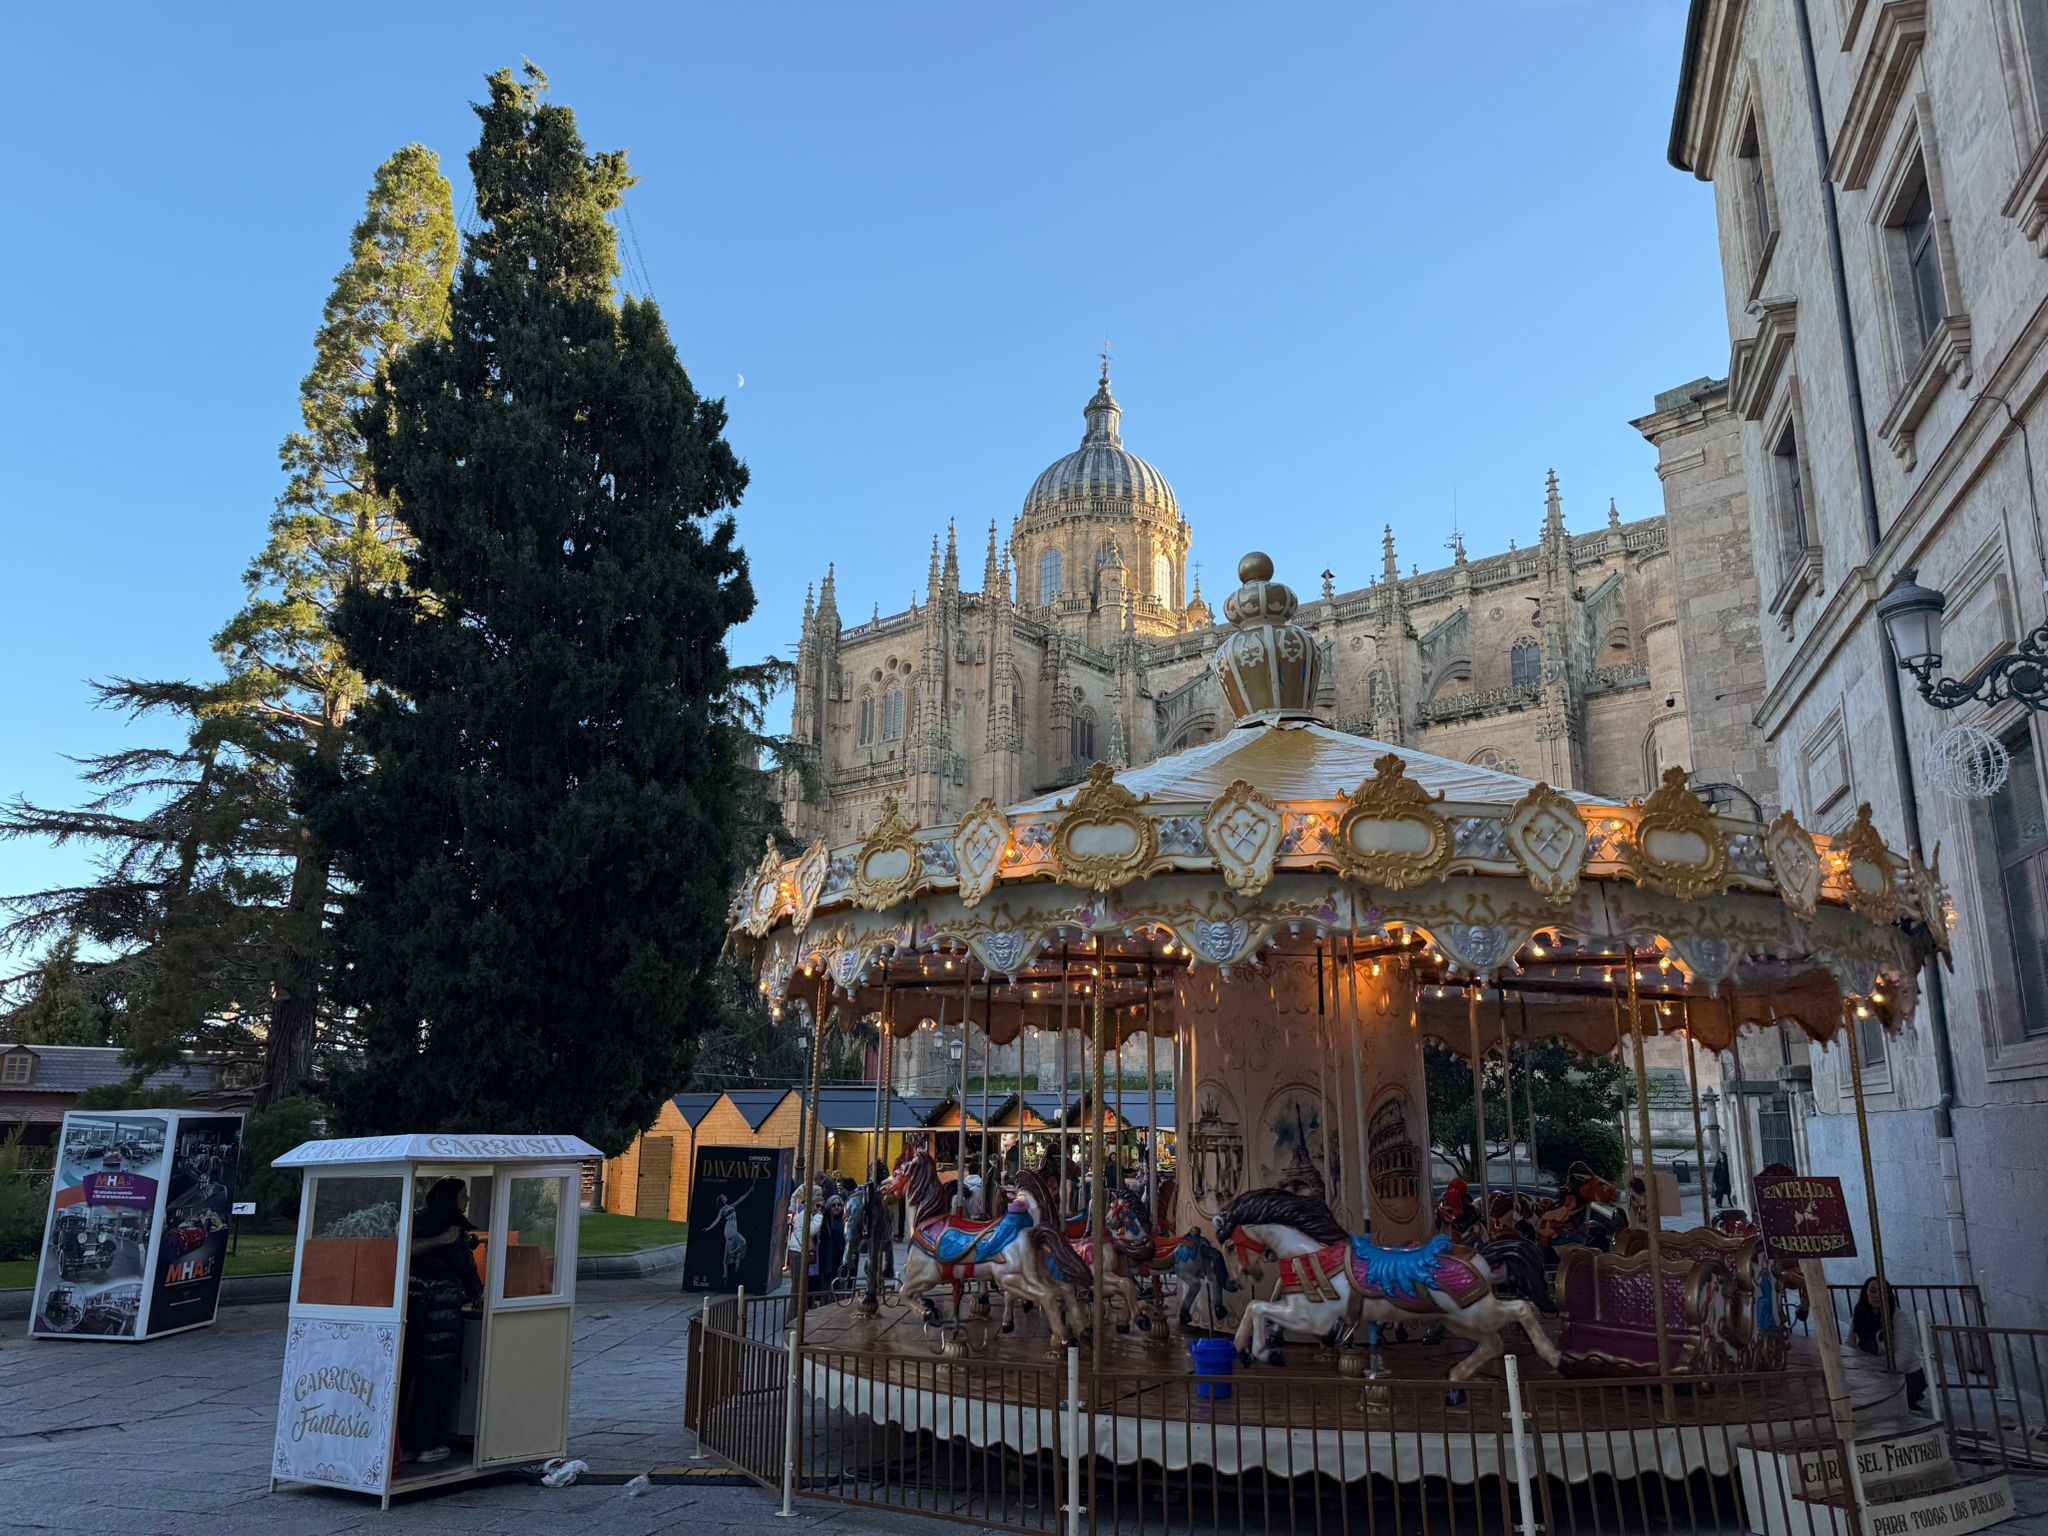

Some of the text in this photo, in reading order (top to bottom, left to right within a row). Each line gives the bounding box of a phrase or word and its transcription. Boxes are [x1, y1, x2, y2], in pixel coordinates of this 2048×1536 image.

[296, 1138, 398, 1160] CARRUSEL
[427, 1136, 576, 1155] CARRUSEL
[95, 1175, 125, 1186] MHA
[1762, 1181, 1837, 1199] ENTRADA
[1769, 1234, 1849, 1252] CARRUSEL
[165, 1260, 203, 1283] MHA
[294, 1365, 376, 1412] CARRUSEL
[291, 1401, 374, 1442] Fantasía
[1873, 1513, 1909, 1536] PARA
[1910, 1505, 1948, 1530] TODOS
[1949, 1500, 1969, 1522] LOS
